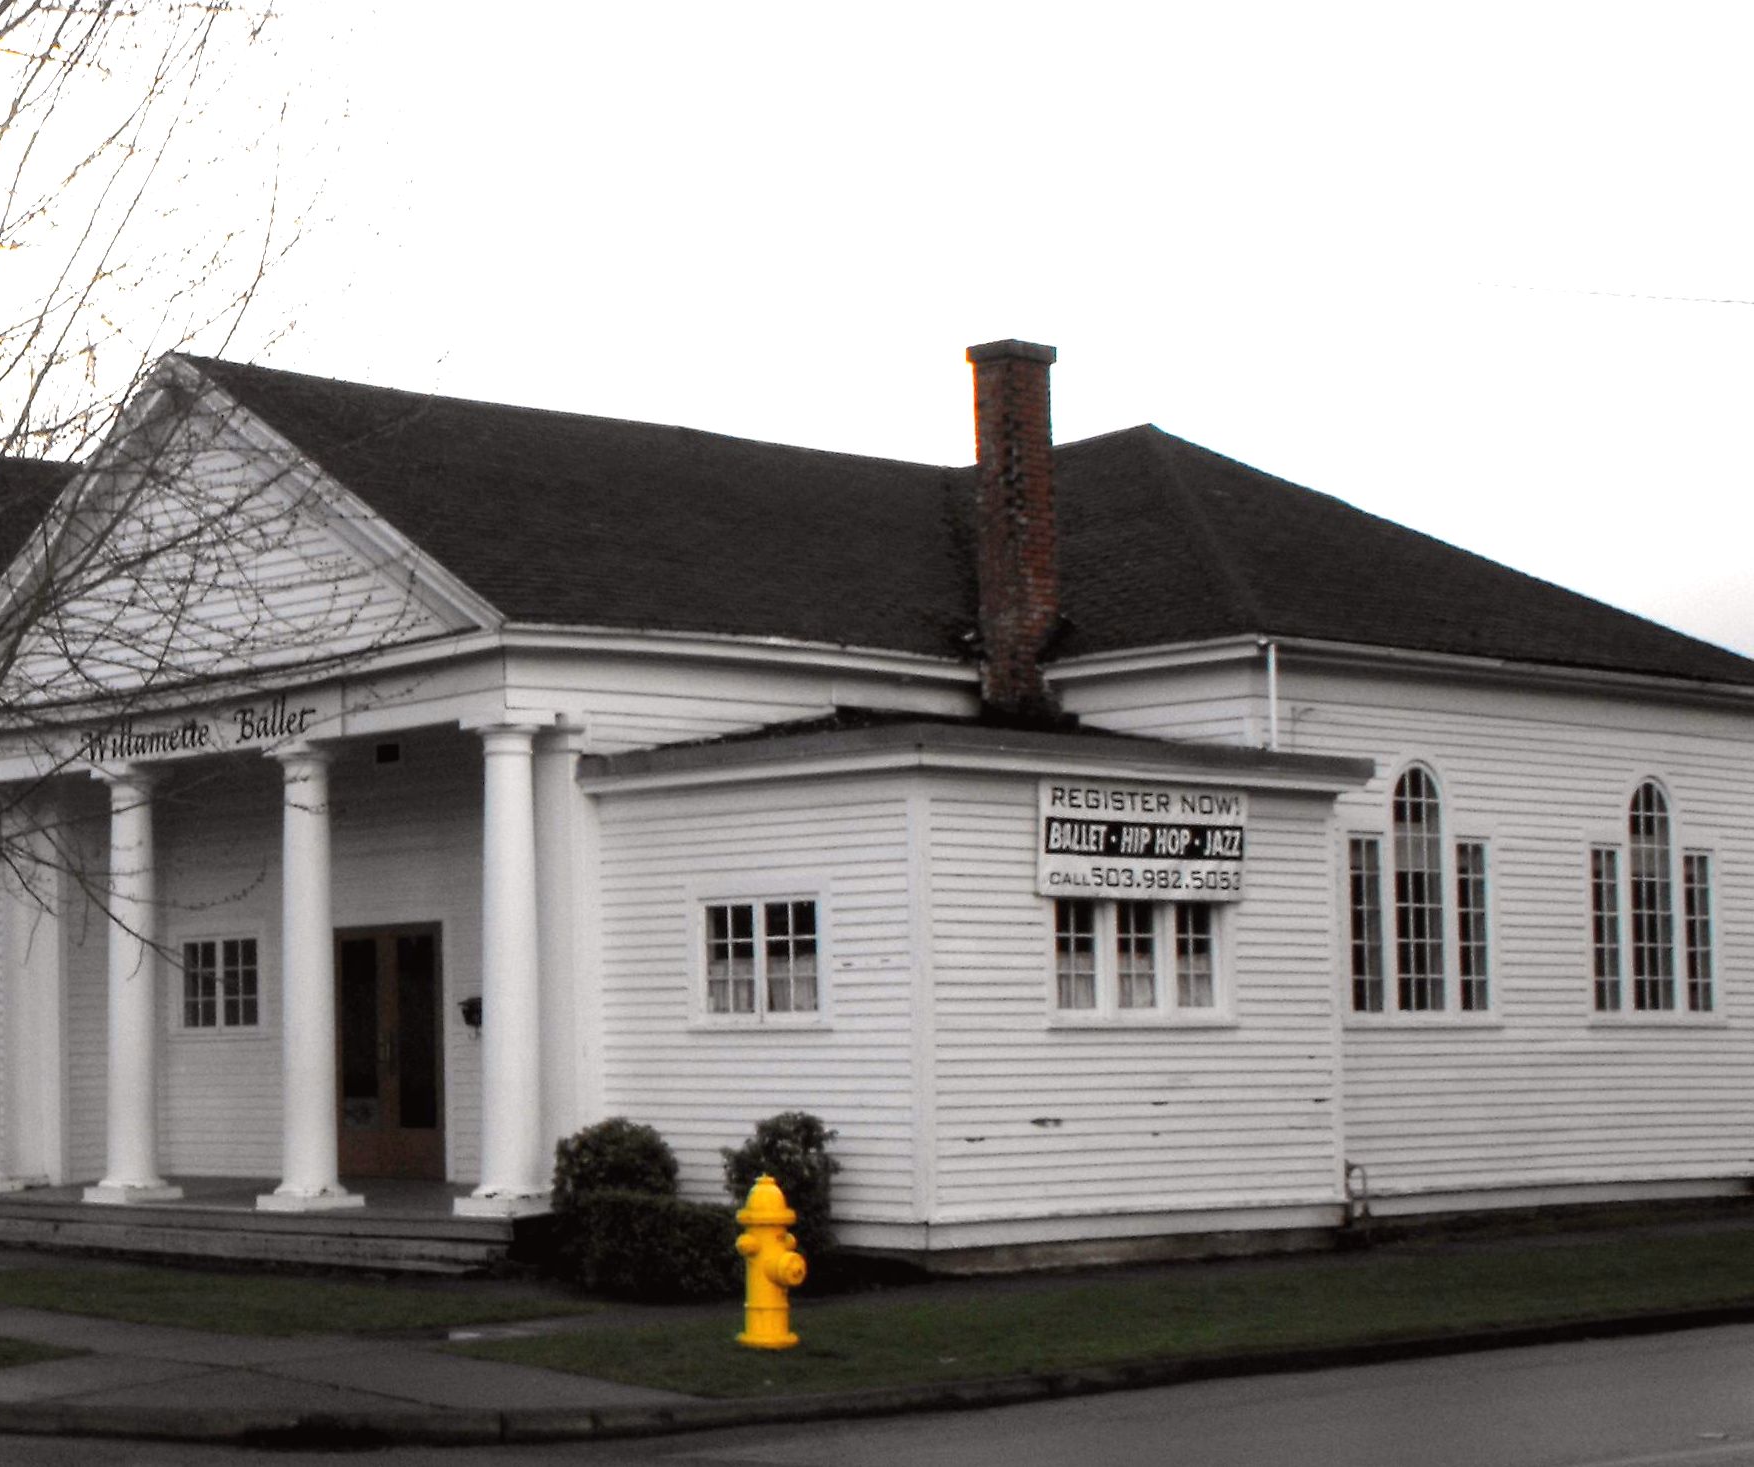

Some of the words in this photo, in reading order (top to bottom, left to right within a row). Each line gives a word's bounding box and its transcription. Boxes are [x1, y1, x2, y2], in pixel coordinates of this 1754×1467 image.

[81, 717, 209, 762] Willamette
[233, 693, 317, 744] Ballet
[1051, 786, 1170, 814] REGISTER
[1181, 796, 1241, 816] NOW!
[1048, 821, 1107, 851] BALLET
[1120, 827, 1151, 854] HIP
[1154, 827, 1191, 855] HOP
[1202, 829, 1242, 857] JAZZ
[1049, 871, 1091, 887] CALL
